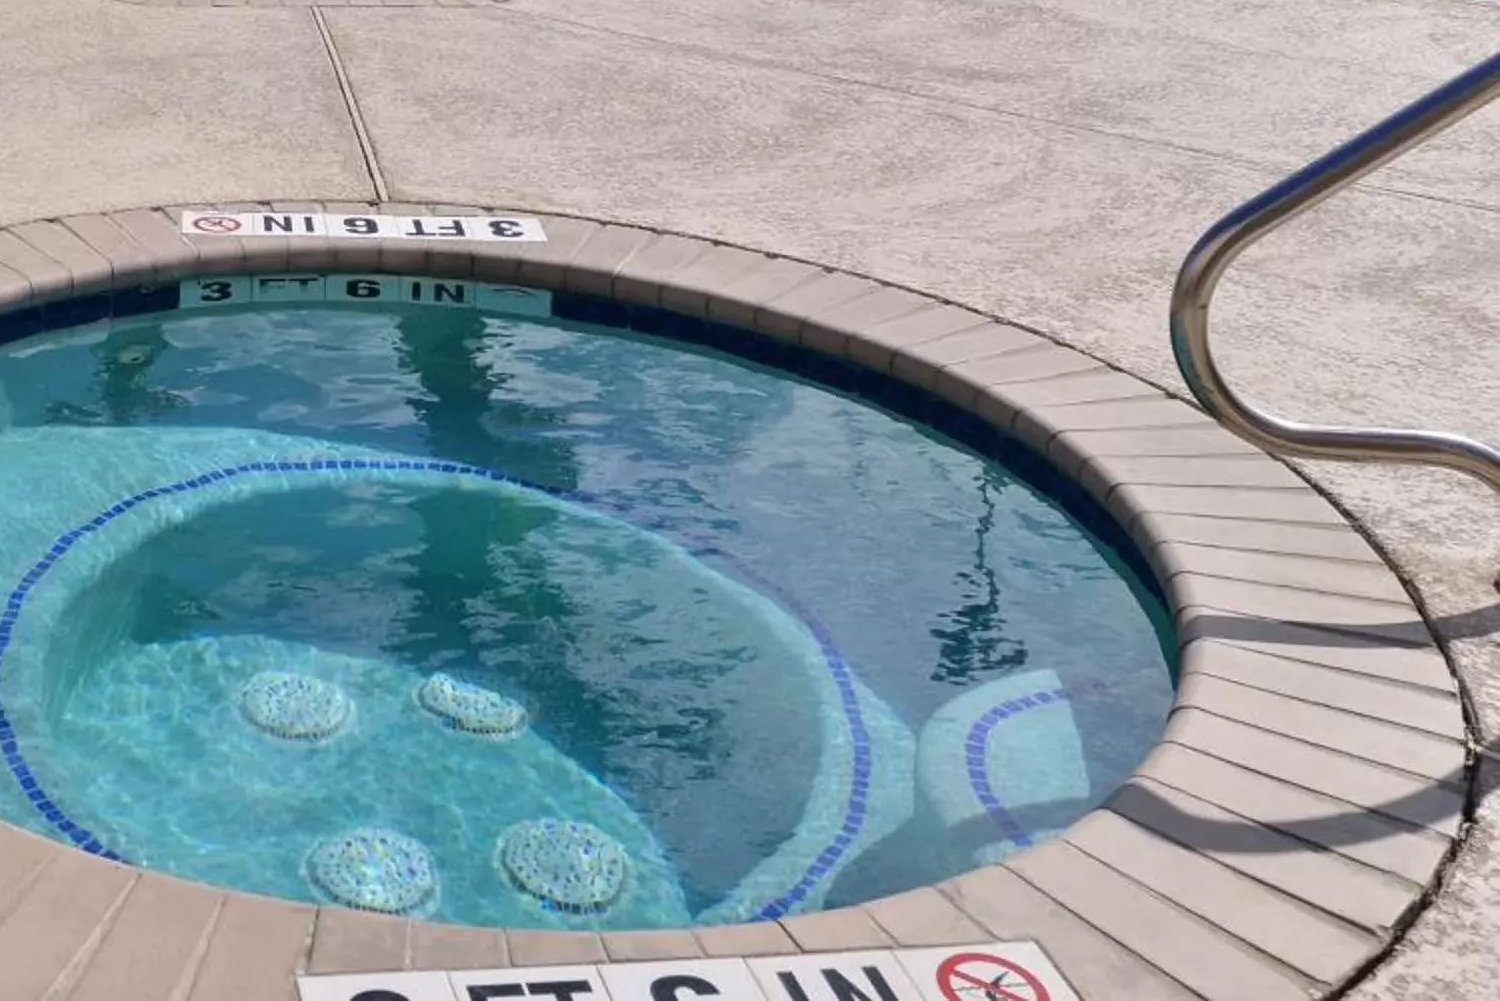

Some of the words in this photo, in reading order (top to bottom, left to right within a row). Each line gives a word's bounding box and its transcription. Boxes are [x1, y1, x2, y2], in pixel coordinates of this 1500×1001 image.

[263, 215, 315, 232] IN
[343, 217, 379, 234] 6
[405, 219, 466, 237] FT
[488, 220, 524, 238] 3
[200, 280, 232, 301] 3
[346, 278, 381, 299] 6
[411, 280, 465, 304] IN
